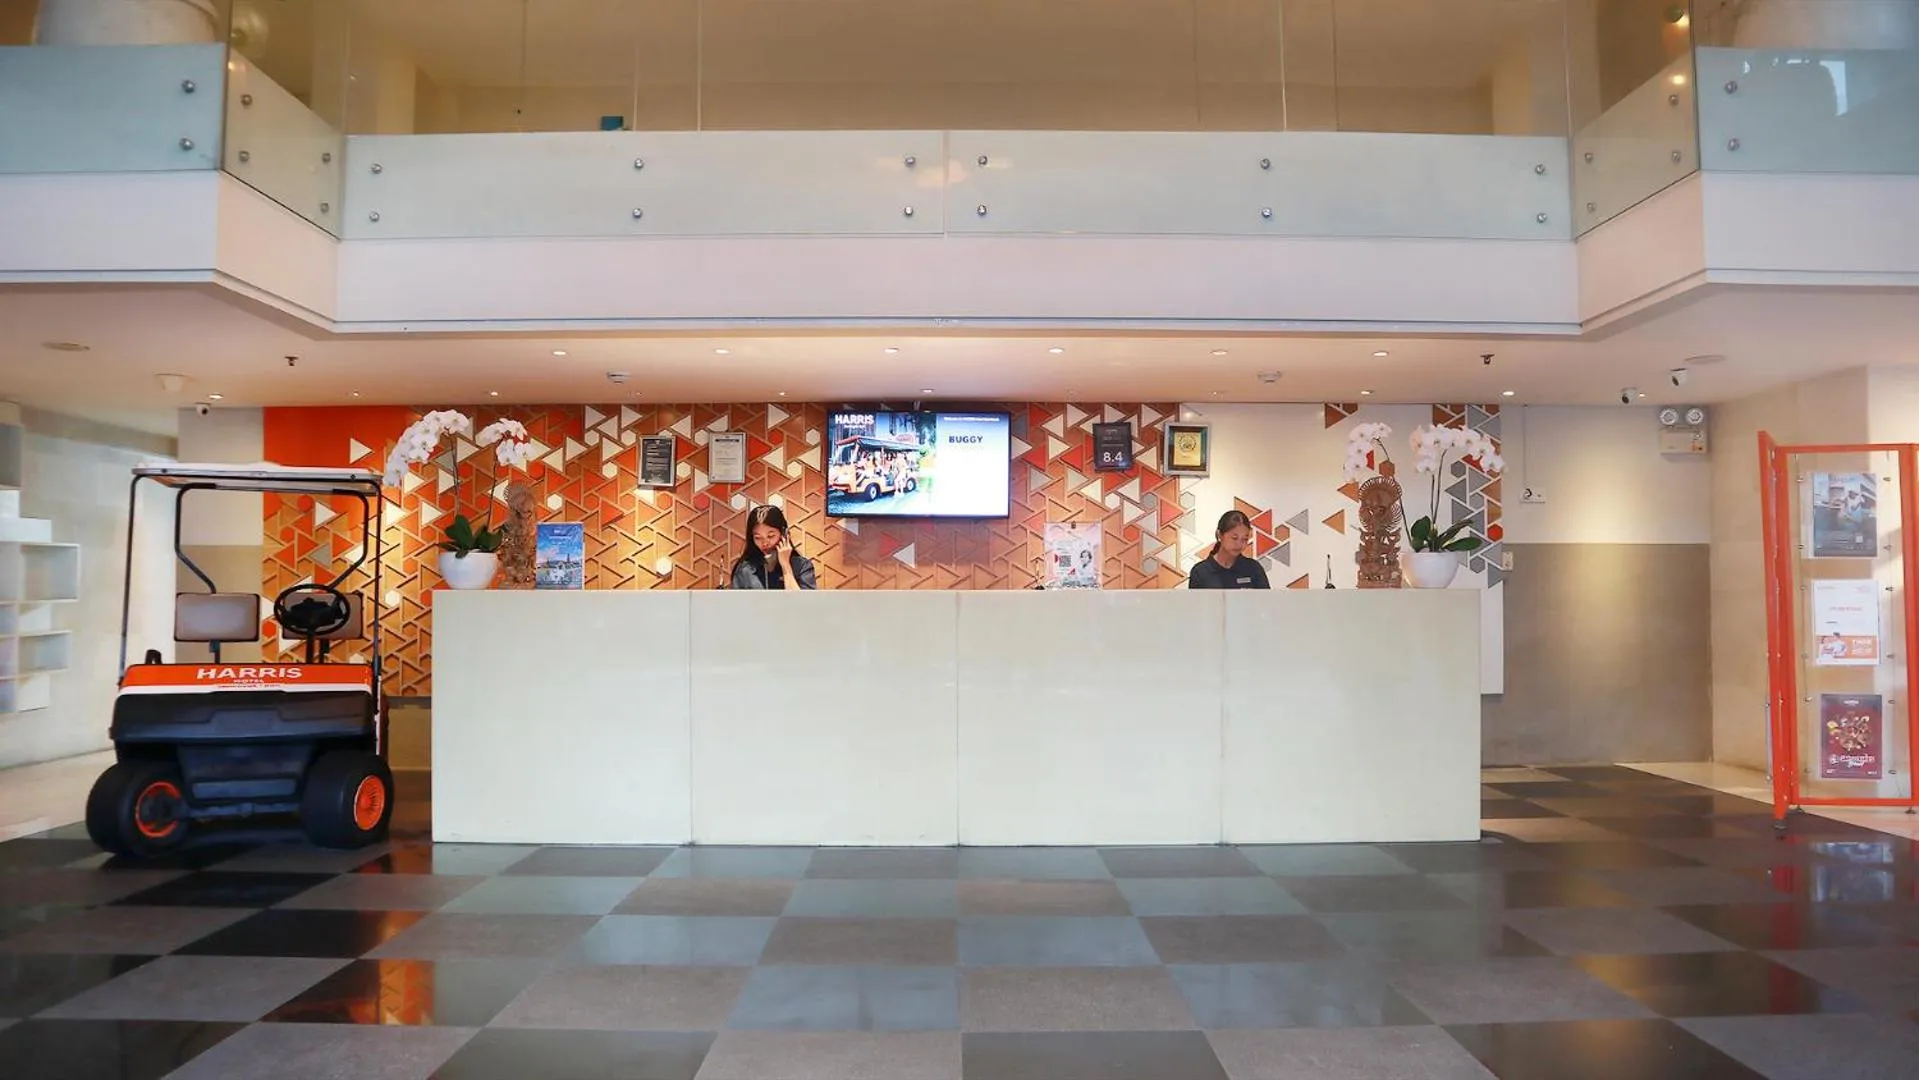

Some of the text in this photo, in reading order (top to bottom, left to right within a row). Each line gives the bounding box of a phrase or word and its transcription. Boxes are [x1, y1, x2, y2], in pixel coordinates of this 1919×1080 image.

[834, 414, 874, 424] HARRIS
[949, 435, 983, 443] BUGGY
[1103, 451, 1123, 462] 8.4
[197, 667, 303, 679] HARRIS
